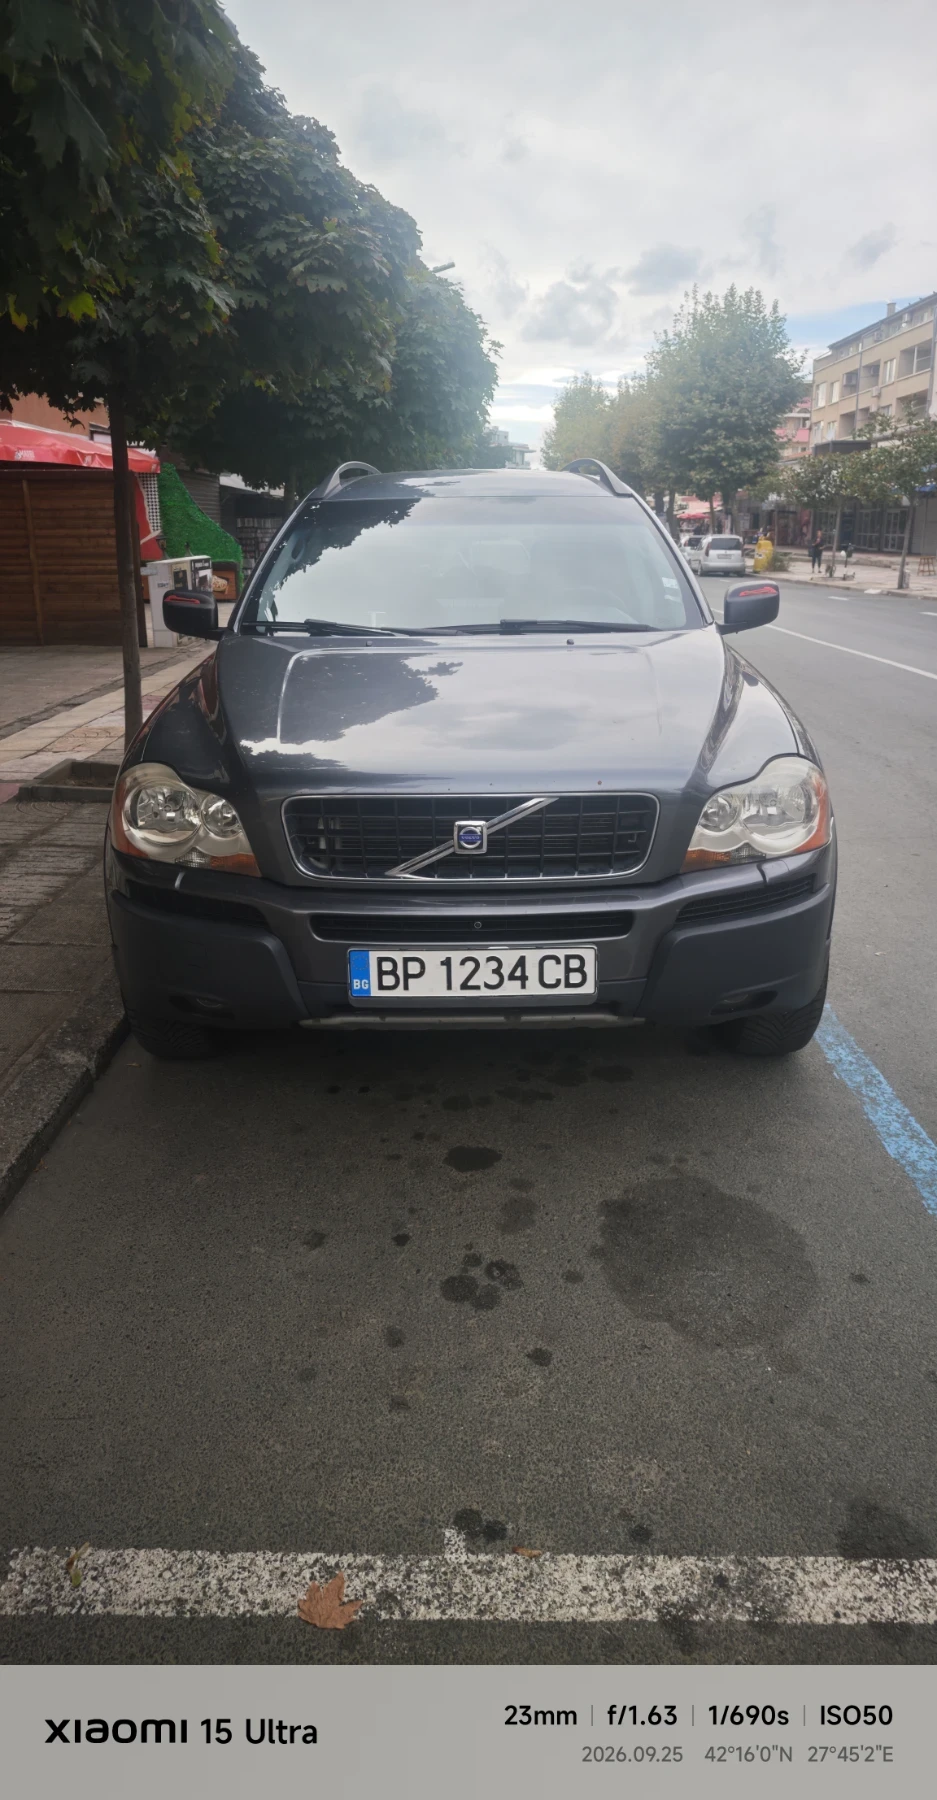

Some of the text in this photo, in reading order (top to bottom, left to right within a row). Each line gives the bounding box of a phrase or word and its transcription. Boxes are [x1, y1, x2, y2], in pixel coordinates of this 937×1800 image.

[353, 979, 369, 990] BG
[377, 954, 588, 991] BP 1234 CB
